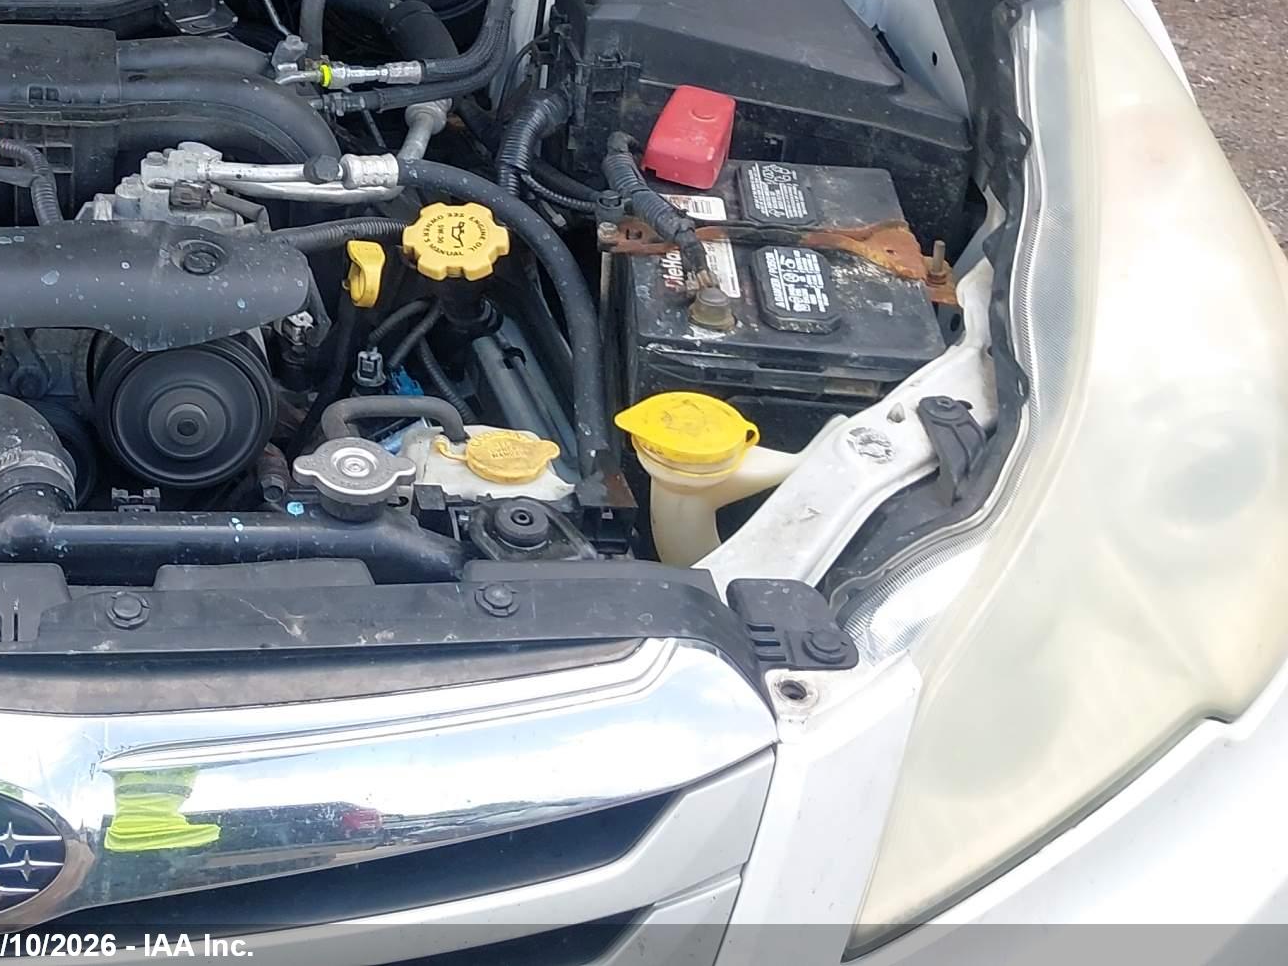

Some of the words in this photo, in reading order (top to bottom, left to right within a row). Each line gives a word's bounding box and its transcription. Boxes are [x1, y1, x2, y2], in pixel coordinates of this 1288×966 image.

[467, 215, 488, 241] ENGINE
[428, 243, 465, 257] MANUAL
[469, 242, 484, 253] OIL
